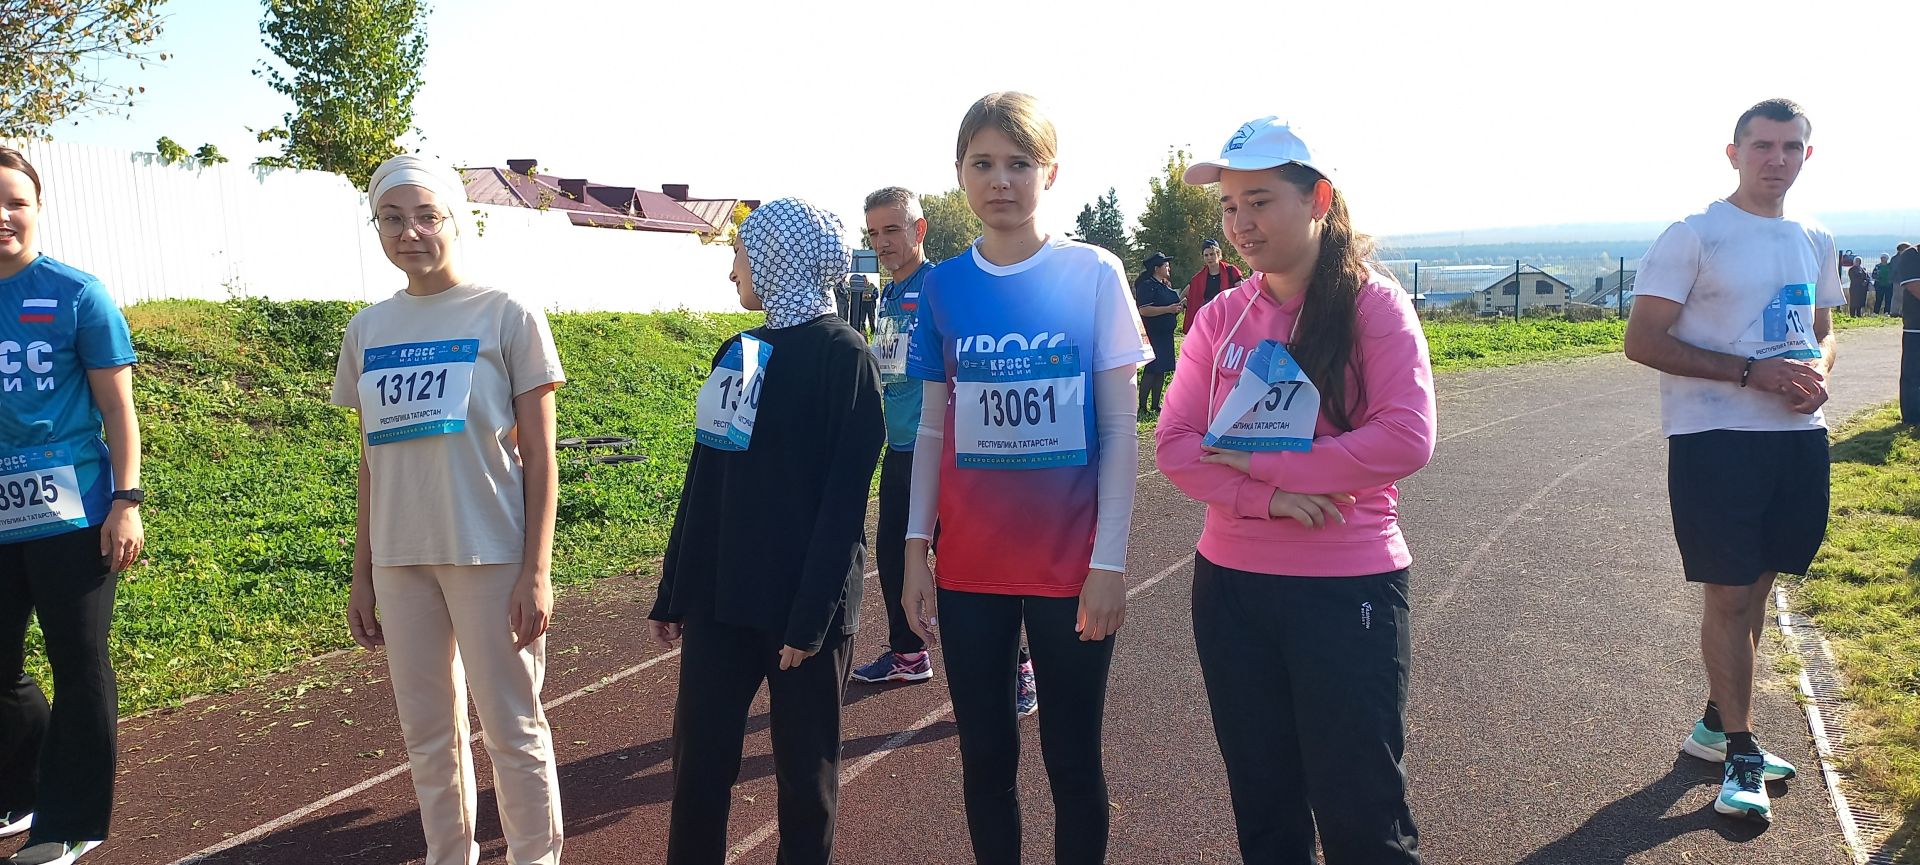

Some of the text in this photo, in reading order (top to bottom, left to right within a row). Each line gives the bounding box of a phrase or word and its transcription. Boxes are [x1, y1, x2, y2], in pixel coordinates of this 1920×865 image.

[400, 347, 436, 359] КРОСС
[990, 356, 1031, 371] КРОСС
[376, 368, 448, 407] 13121
[979, 385, 1057, 427] 13061
[380, 408, 442, 425] РЕСПУБЛИКА ТАТАРСТАН
[1254, 421, 1290, 430] ТАТАРСТАН
[977, 438, 1059, 449] РЕСПУБЛИКА ТАТАРСТАН
